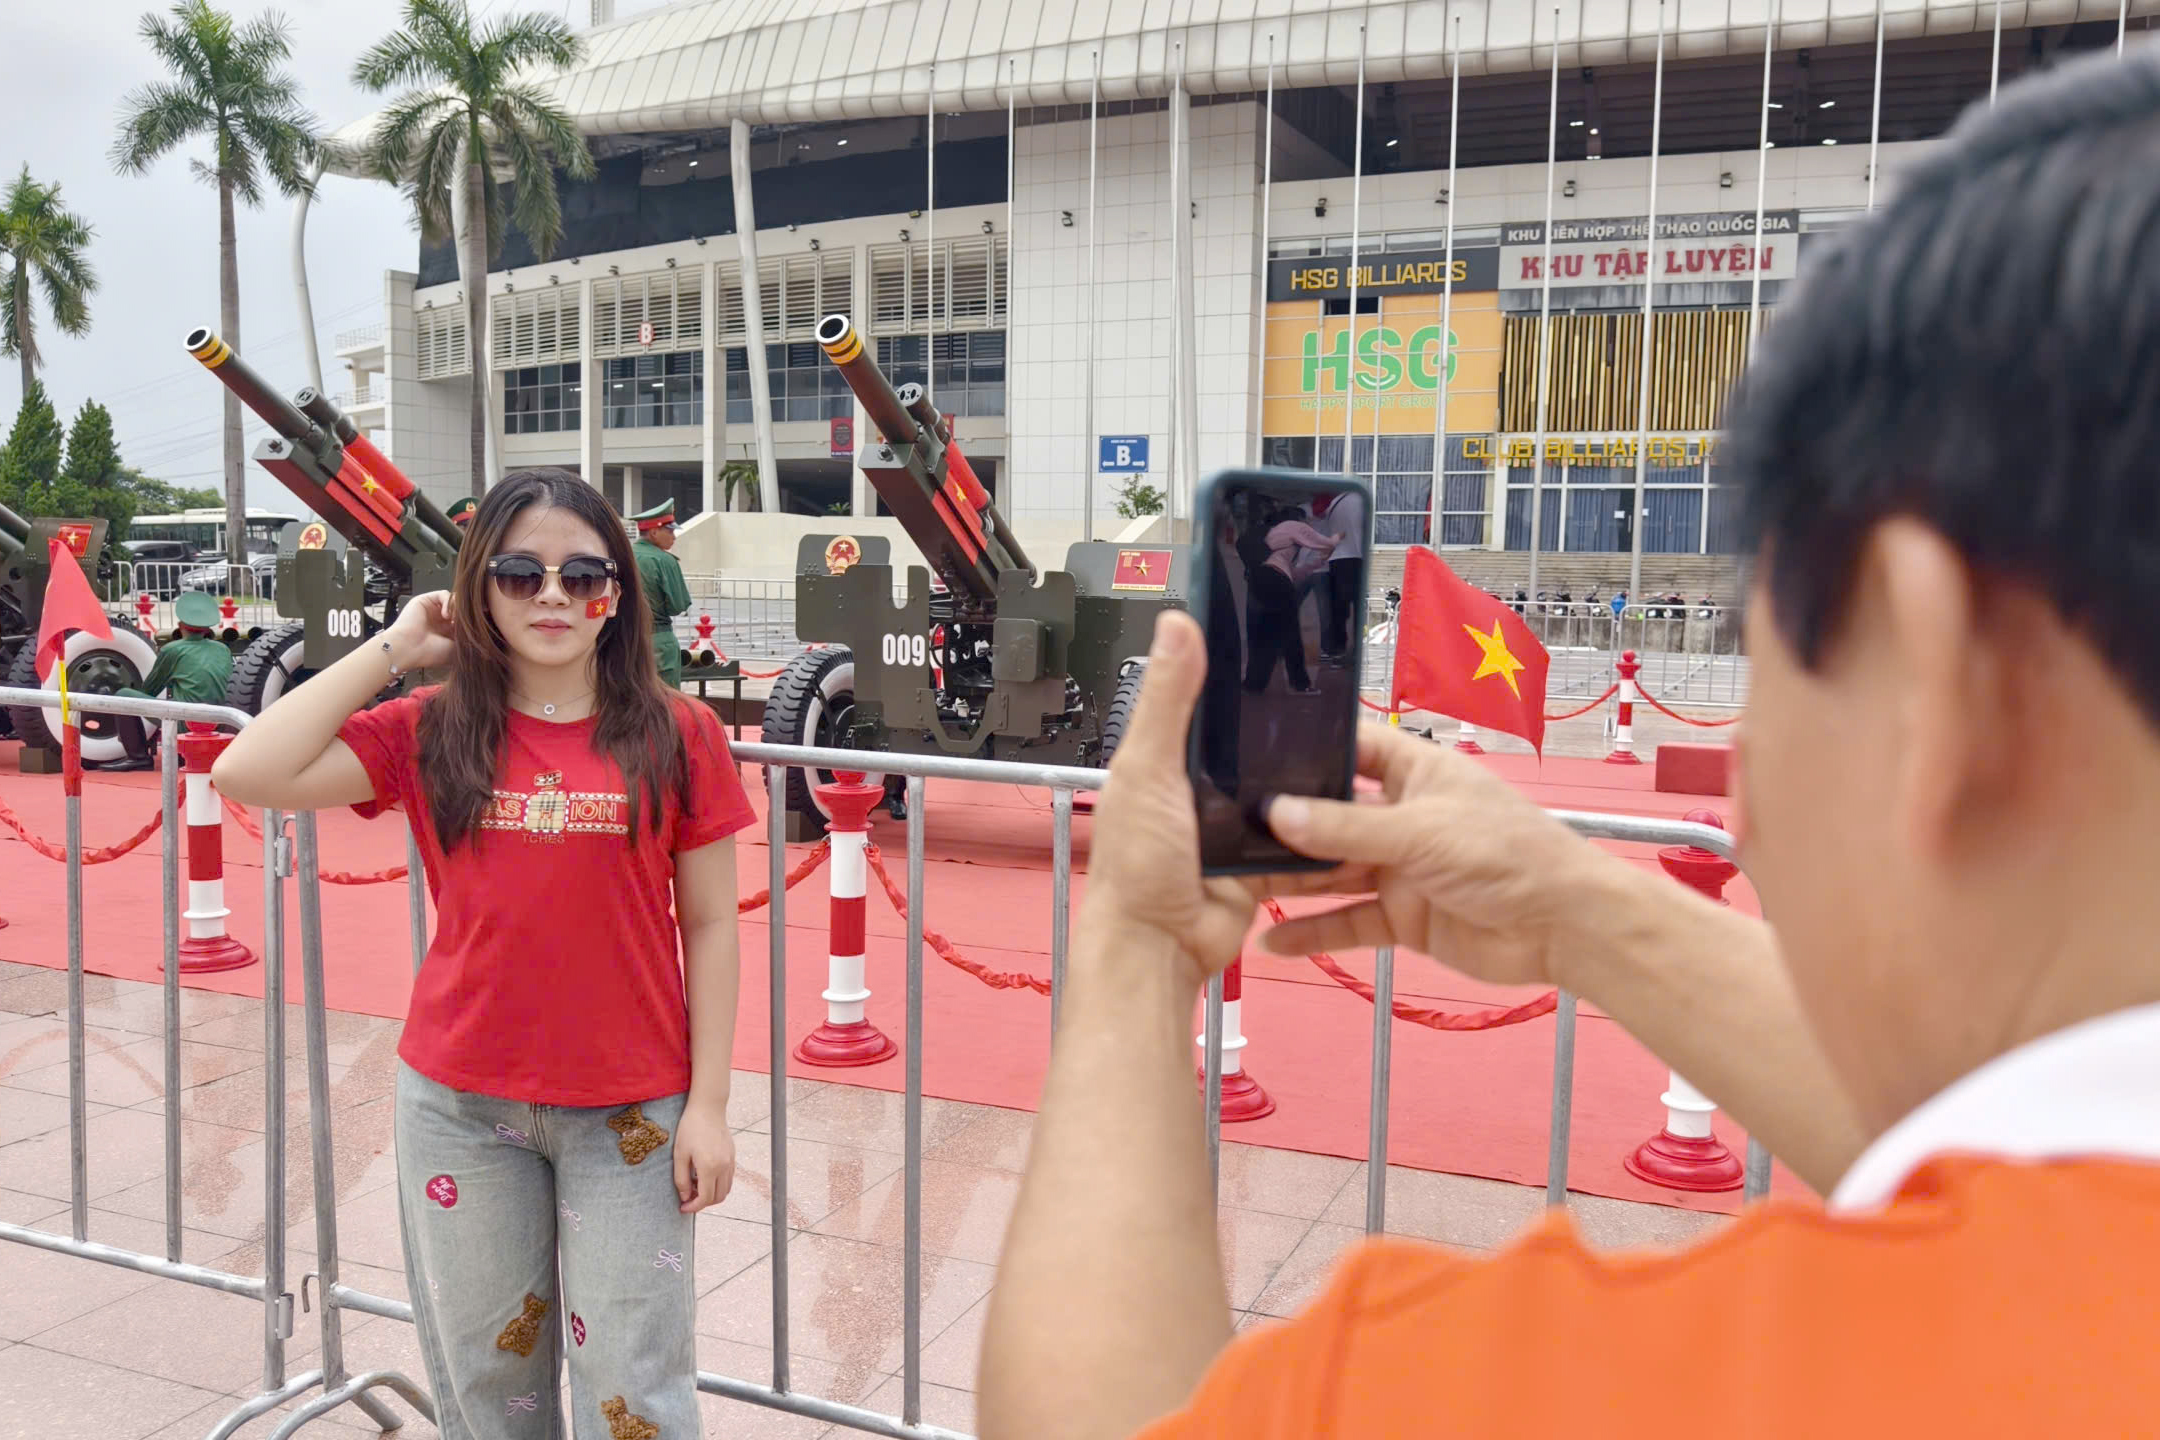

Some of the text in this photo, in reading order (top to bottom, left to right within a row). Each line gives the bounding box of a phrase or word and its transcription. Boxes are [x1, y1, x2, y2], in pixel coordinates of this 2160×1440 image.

[1508, 229, 1540, 241] KHU
[1550, 224, 1579, 240] IÊN
[1656, 222, 1701, 235] THAO
[1707, 215, 1755, 232] QUỐC
[1760, 217, 1790, 230] GIA
[1520, 254, 1584, 279] KHU
[1665, 243, 1773, 276] LUYỆN
[1291, 260, 1467, 291] HSG BILLIARDS
[641, 323, 652, 344] B
[1302, 324, 1459, 392] HSG
[1301, 397, 1346, 410] HAPPY
[1117, 445, 1130, 466] B
[1463, 437, 1533, 459] CLUB
[328, 608, 361, 637] 008
[882, 633, 925, 667] 009
